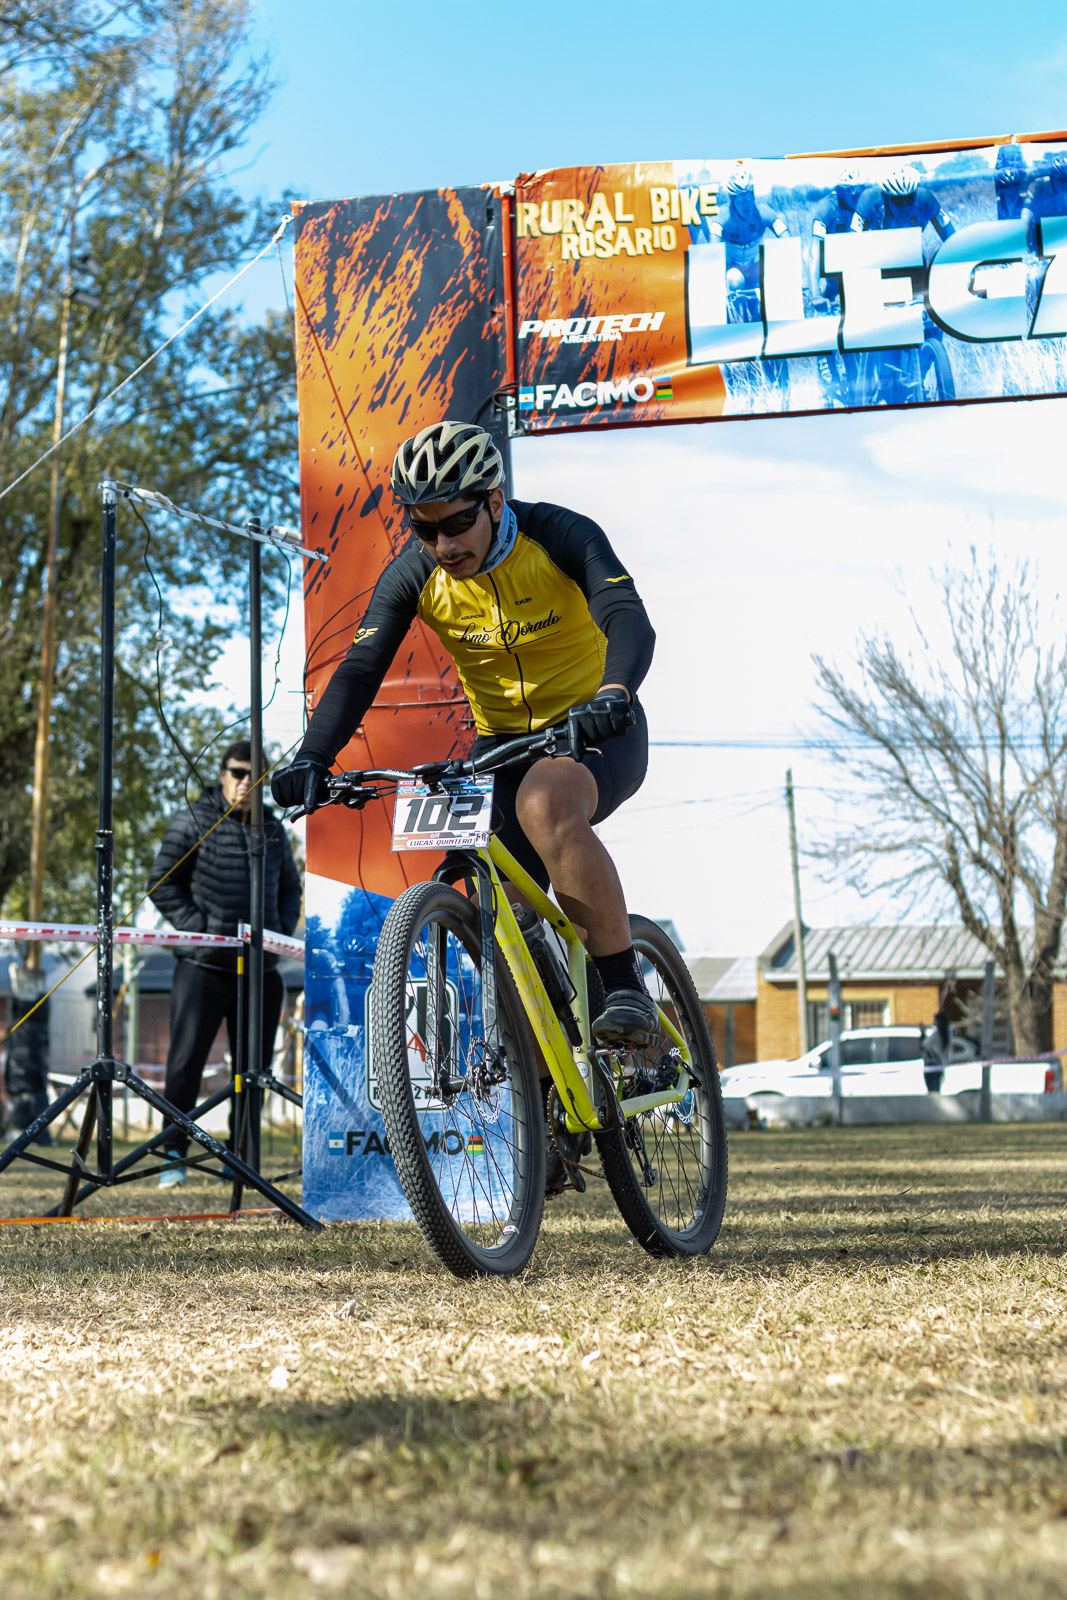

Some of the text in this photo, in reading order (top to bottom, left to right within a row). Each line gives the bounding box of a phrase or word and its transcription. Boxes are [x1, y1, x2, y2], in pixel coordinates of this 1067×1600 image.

[516, 183, 720, 238] RURAL BIKE
[561, 225, 678, 261] ROSARIO
[517, 311, 666, 340] PROTECH
[559, 331, 623, 344] ARGENTINA
[535, 376, 655, 410] FACIMO
[403, 795, 485, 833] 102
[409, 839, 434, 847] LUCAS
[436, 837, 473, 846] QUINTERO
[346, 1129, 465, 1156] FAMO
